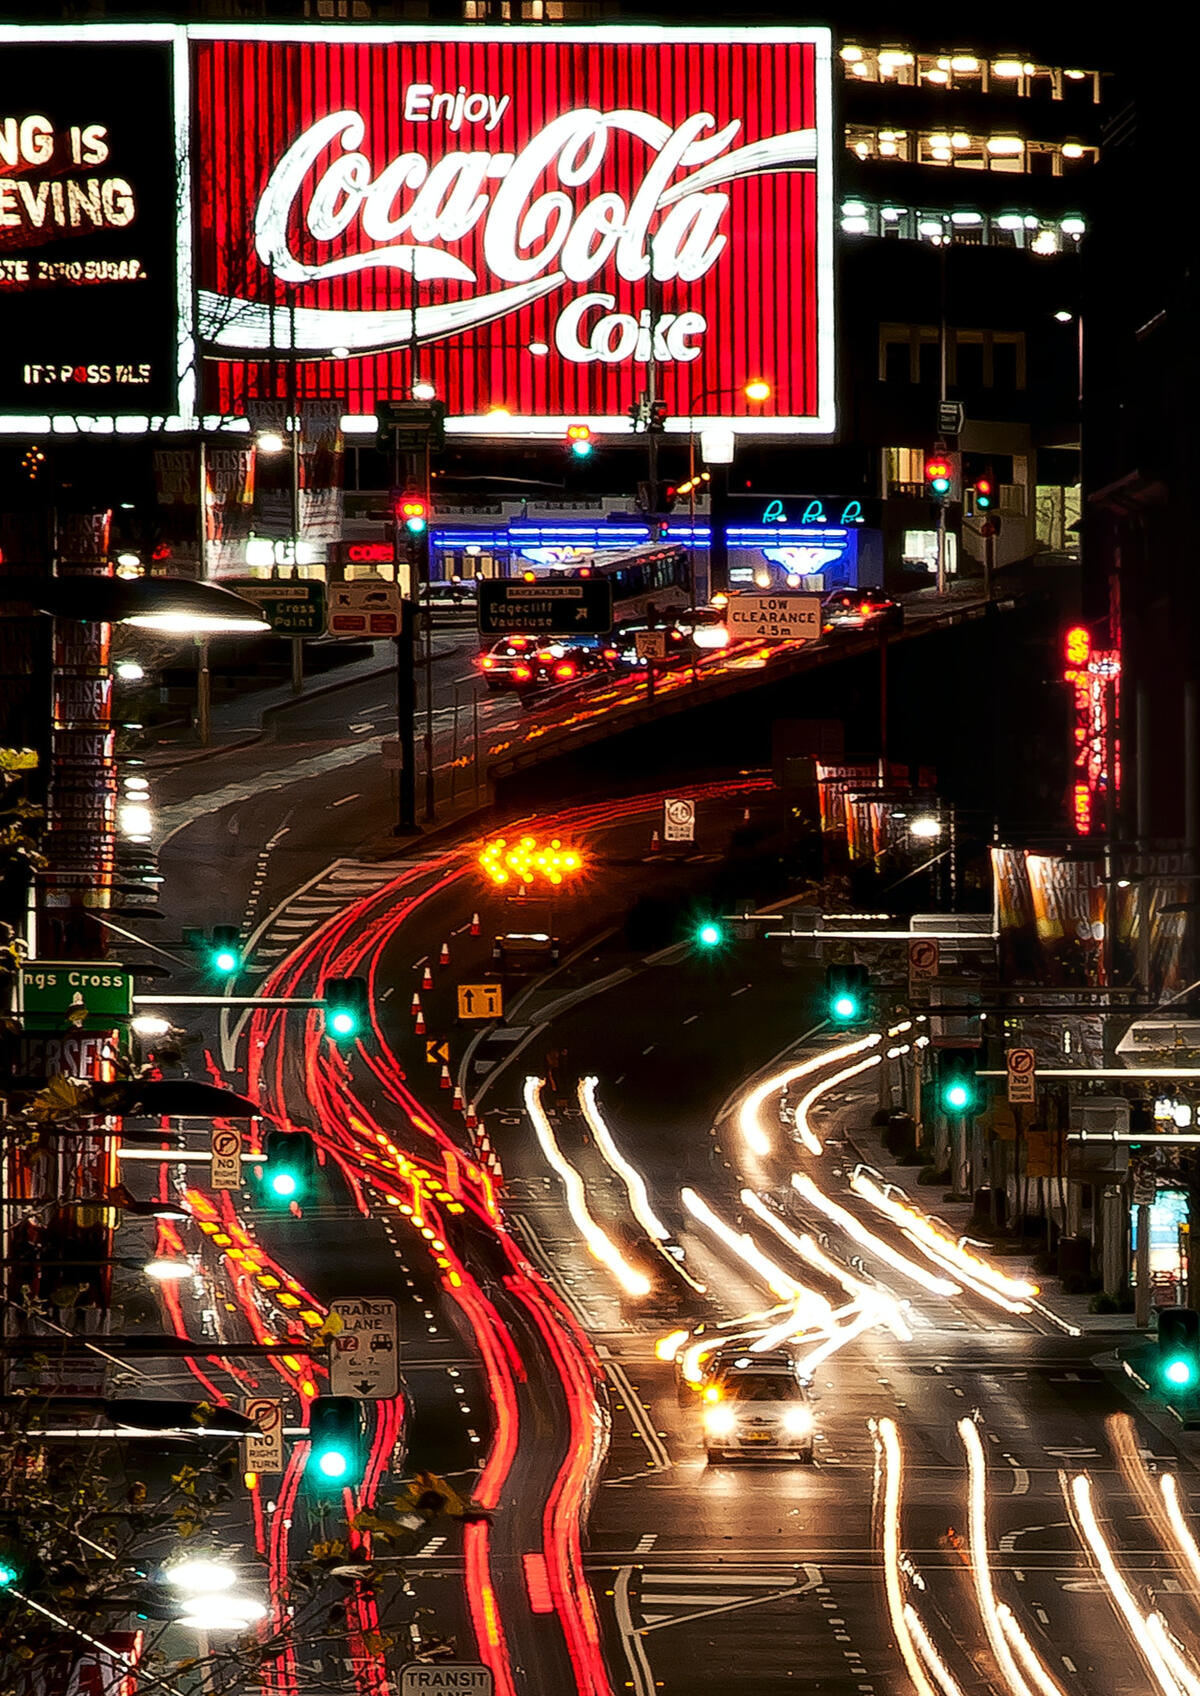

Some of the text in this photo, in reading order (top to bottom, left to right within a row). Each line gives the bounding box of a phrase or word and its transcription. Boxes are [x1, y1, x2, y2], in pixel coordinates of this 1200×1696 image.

[403, 83, 510, 131] Enjoy
[70, 124, 109, 164] IS
[254, 108, 741, 283] Coca-Cola
[0, 178, 135, 227] EVING
[555, 293, 707, 362] Coke
[208, 450, 251, 472] JERSEY
[215, 472, 246, 492] BOYS
[276, 602, 316, 614] Cross
[490, 602, 553, 617] Edgecliff
[759, 600, 788, 610] LOW
[274, 616, 314, 627] Point
[490, 617, 553, 627] Vaucluse
[732, 612, 816, 624] CLEARANCE
[756, 625, 791, 636] 4.5m
[68, 972, 123, 987] Cross
[1013, 1075, 1029, 1084] NO
[217, 1159, 234, 1169] NO
[333, 1303, 394, 1315] TRANSIT
[343, 1319, 383, 1330] LANE
[338, 1336, 357, 1351] T2
[253, 1434, 274, 1446] NO
[249, 1449, 279, 1458] RIGHT
[250, 1460, 279, 1469] TURN
[406, 1671, 488, 1687] TRANSIT
